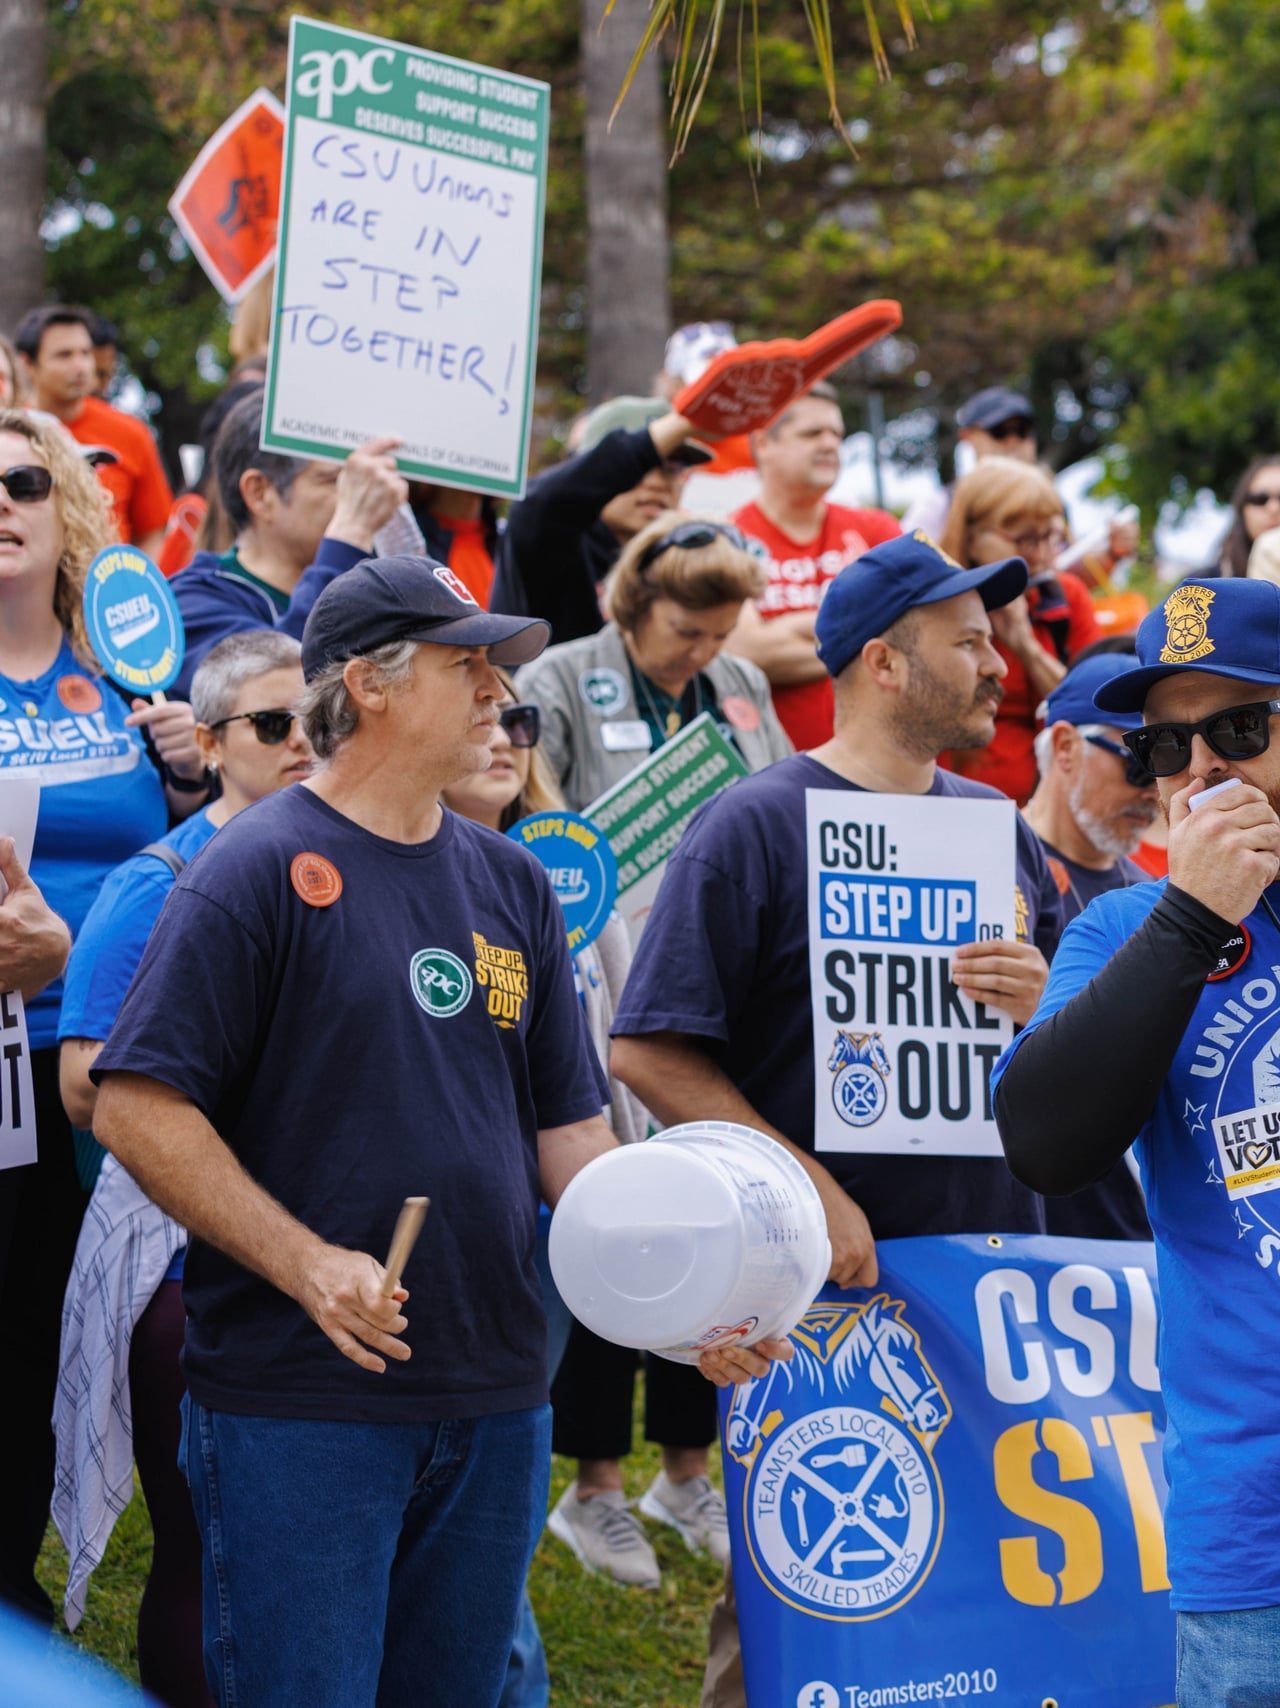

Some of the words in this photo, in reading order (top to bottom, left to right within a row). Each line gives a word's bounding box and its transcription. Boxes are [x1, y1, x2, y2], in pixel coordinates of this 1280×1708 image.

[296, 48, 396, 119] apc
[406, 57, 478, 95] PROVIDING
[480, 77, 540, 110] STUDENT
[354, 106, 425, 142] DESERVES
[426, 124, 508, 164] SUCCESSFUL
[510, 146, 537, 170] PAY
[416, 91, 477, 125] SUPPORT
[478, 107, 538, 141] SUCCESS
[312, 134, 401, 182] CSU
[311, 199, 383, 241] ARE
[415, 225, 482, 267] IN
[321, 257, 461, 313] STEP
[281, 304, 517, 416] TOGETHER!
[280, 418, 342, 440] ACADEMIC
[431, 447, 447, 463] OF
[447, 451, 511, 475] CALIFORNIA
[104, 593, 151, 628] CSUEU
[1161, 652, 1188, 664] LOCAL
[1190, 645, 1211, 660] 2010
[0, 710, 114, 753] SUEU
[50, 748, 85, 762] Local
[648, 729, 710, 787] STUDENT
[666, 752, 729, 810] SUCCESS
[521, 818, 566, 844] STEPS
[819, 820, 897, 872] CSU:
[825, 880, 912, 939] STEP
[920, 887, 973, 942] UP
[979, 923, 1004, 942] OR
[505, 951, 522, 969] UP
[488, 988, 523, 1022] OUT
[897, 1039, 1003, 1122] OUT
[1220, 1117, 1257, 1147] LET
[758, 1415, 835, 1519] TEAMSTERS
[839, 1413, 892, 1451] LOCAL
[895, 1445, 927, 1496] 2010
[782, 1561, 860, 1606] SKILLED
[861, 1548, 919, 1605] TRADES
[844, 1668, 998, 1708] Teamsters2010
